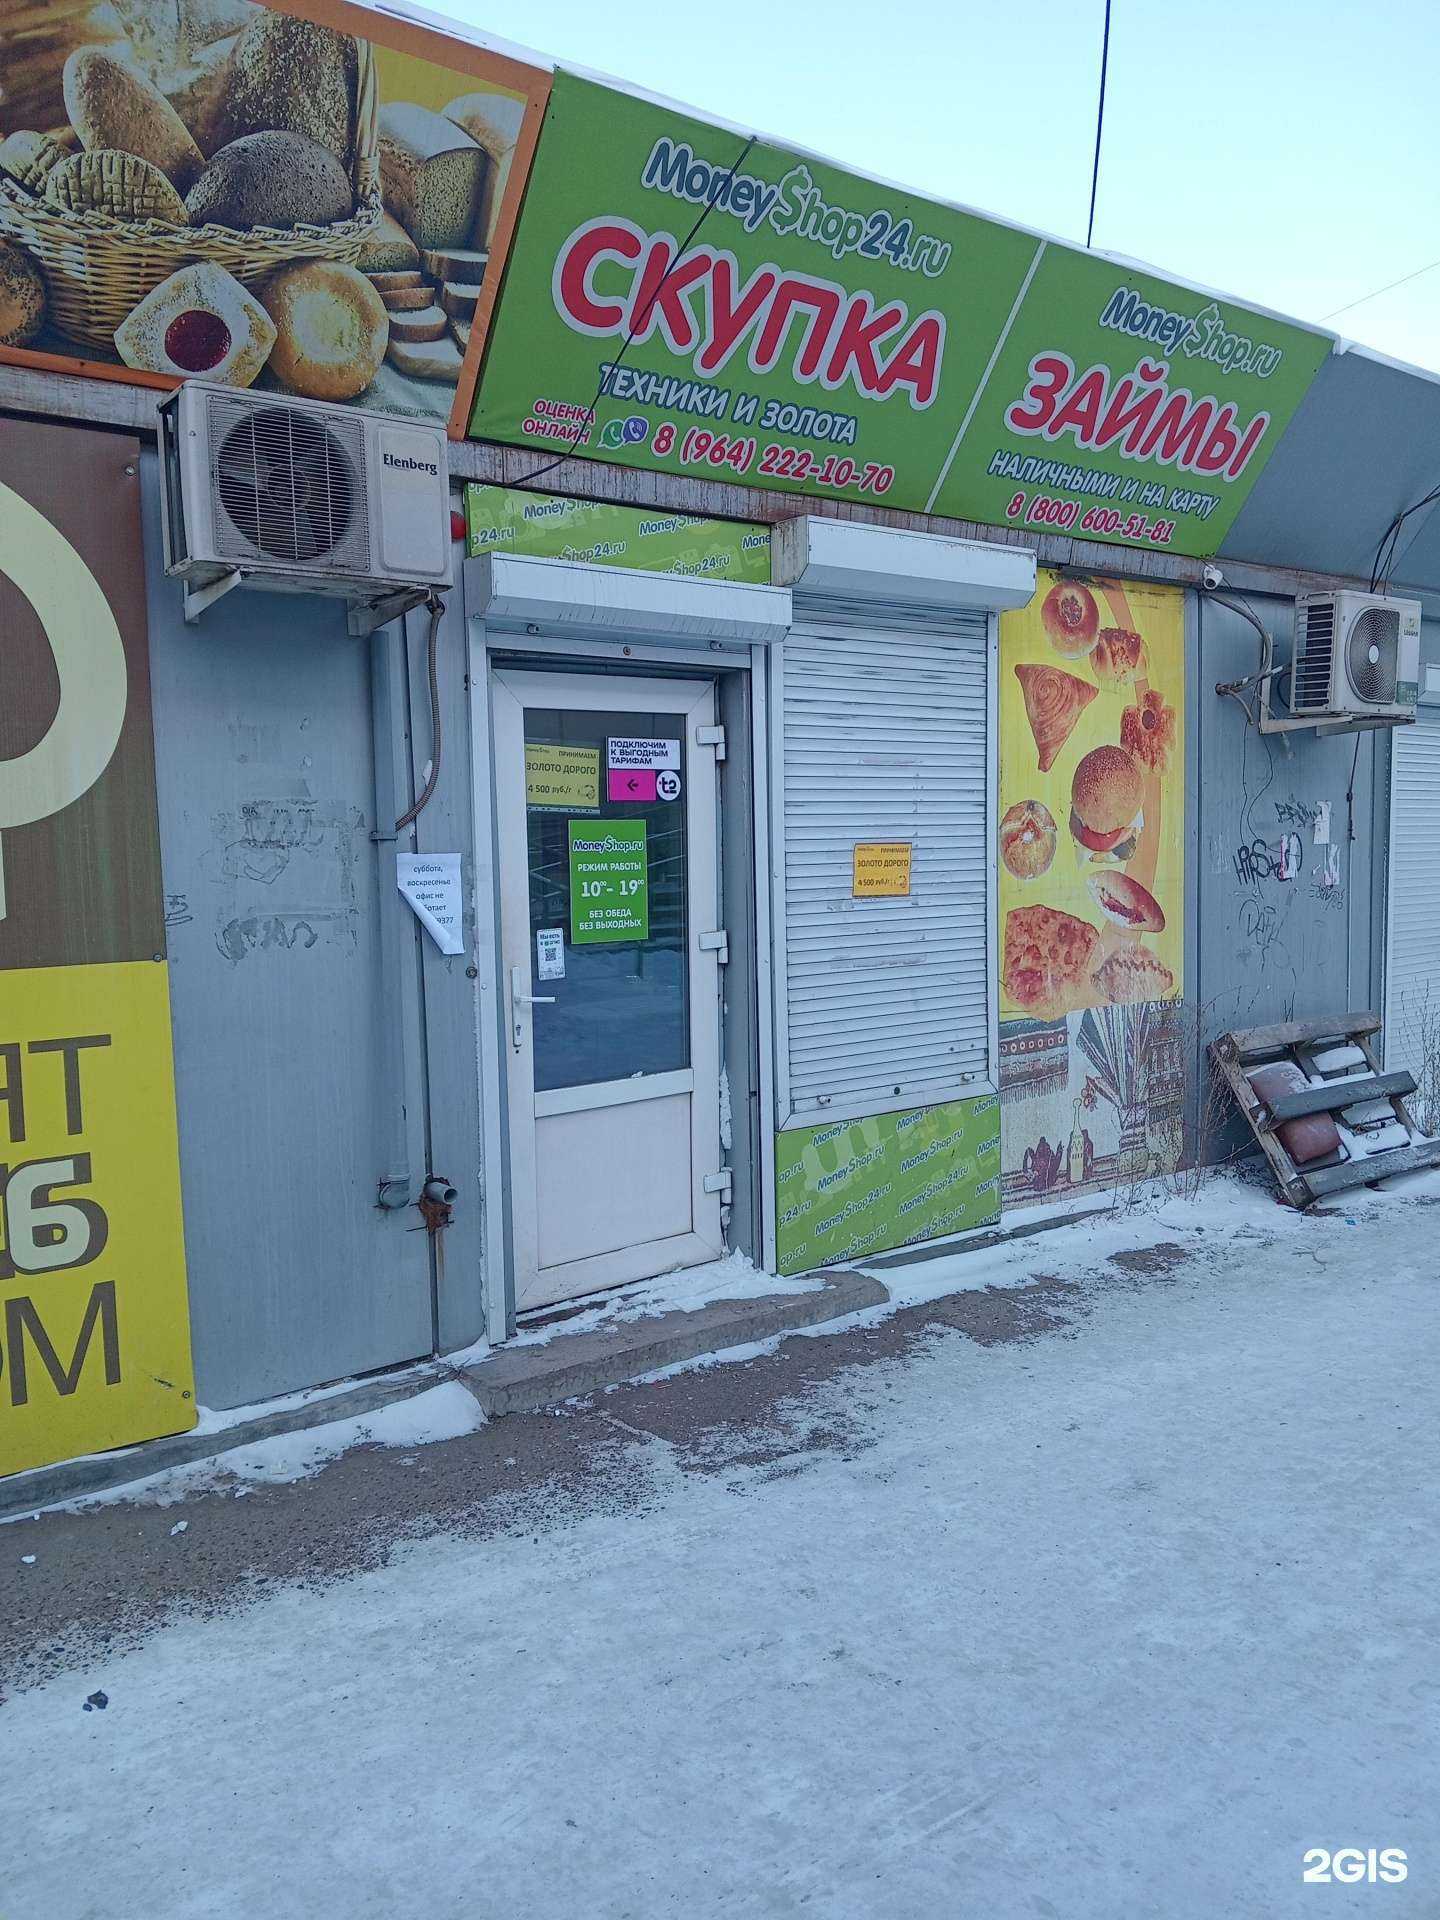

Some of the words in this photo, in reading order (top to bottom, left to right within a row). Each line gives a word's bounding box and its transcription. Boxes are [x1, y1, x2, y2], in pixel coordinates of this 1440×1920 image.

[556, 220, 944, 407] СКУПКА
[534, 400, 595, 424] ОЦЕНКА
[600, 363, 729, 418] ТЕХНИКИ
[734, 393, 758, 424] И
[761, 401, 856, 444] ЗОЛОТА
[1008, 353, 1268, 480] ЗАЙМЫ
[523, 418, 590, 443] ОНЛАЙН
[383, 453, 438, 476] Elenberg
[653, 423, 676, 456] 8
[682, 427, 755, 473] (964)
[759, 445, 894, 494] 222-10-70
[987, 449, 1121, 499] НАЛИЧНЫМИ
[1120, 477, 1138, 501] И
[1140, 481, 1167, 507] НА
[1167, 488, 1220, 520] КАРТУ
[1006, 492, 1026, 518] 8
[1026, 496, 1081, 531] (800)
[1081, 506, 1175, 543] 600-51-81
[611, 741, 666, 749] ПОДКЛЮЧИМ
[620, 749, 668, 757] ВЫГОДНЫМ
[527, 762, 561, 772] ЗОЛОТО
[563, 765, 596, 775] ДОРОГО
[528, 784, 533, 793] 4
[535, 785, 550, 793] 500
[578, 863, 608, 872] РЕЖИМ
[610, 862, 641, 871] РАБОТЫ
[580, 922, 593, 930] БЕЗ
[596, 919, 641, 930] ВЫХОДНЫХ
[589, 910, 603, 918] БЕЗ
[606, 909, 631, 917] ОБЕДА
